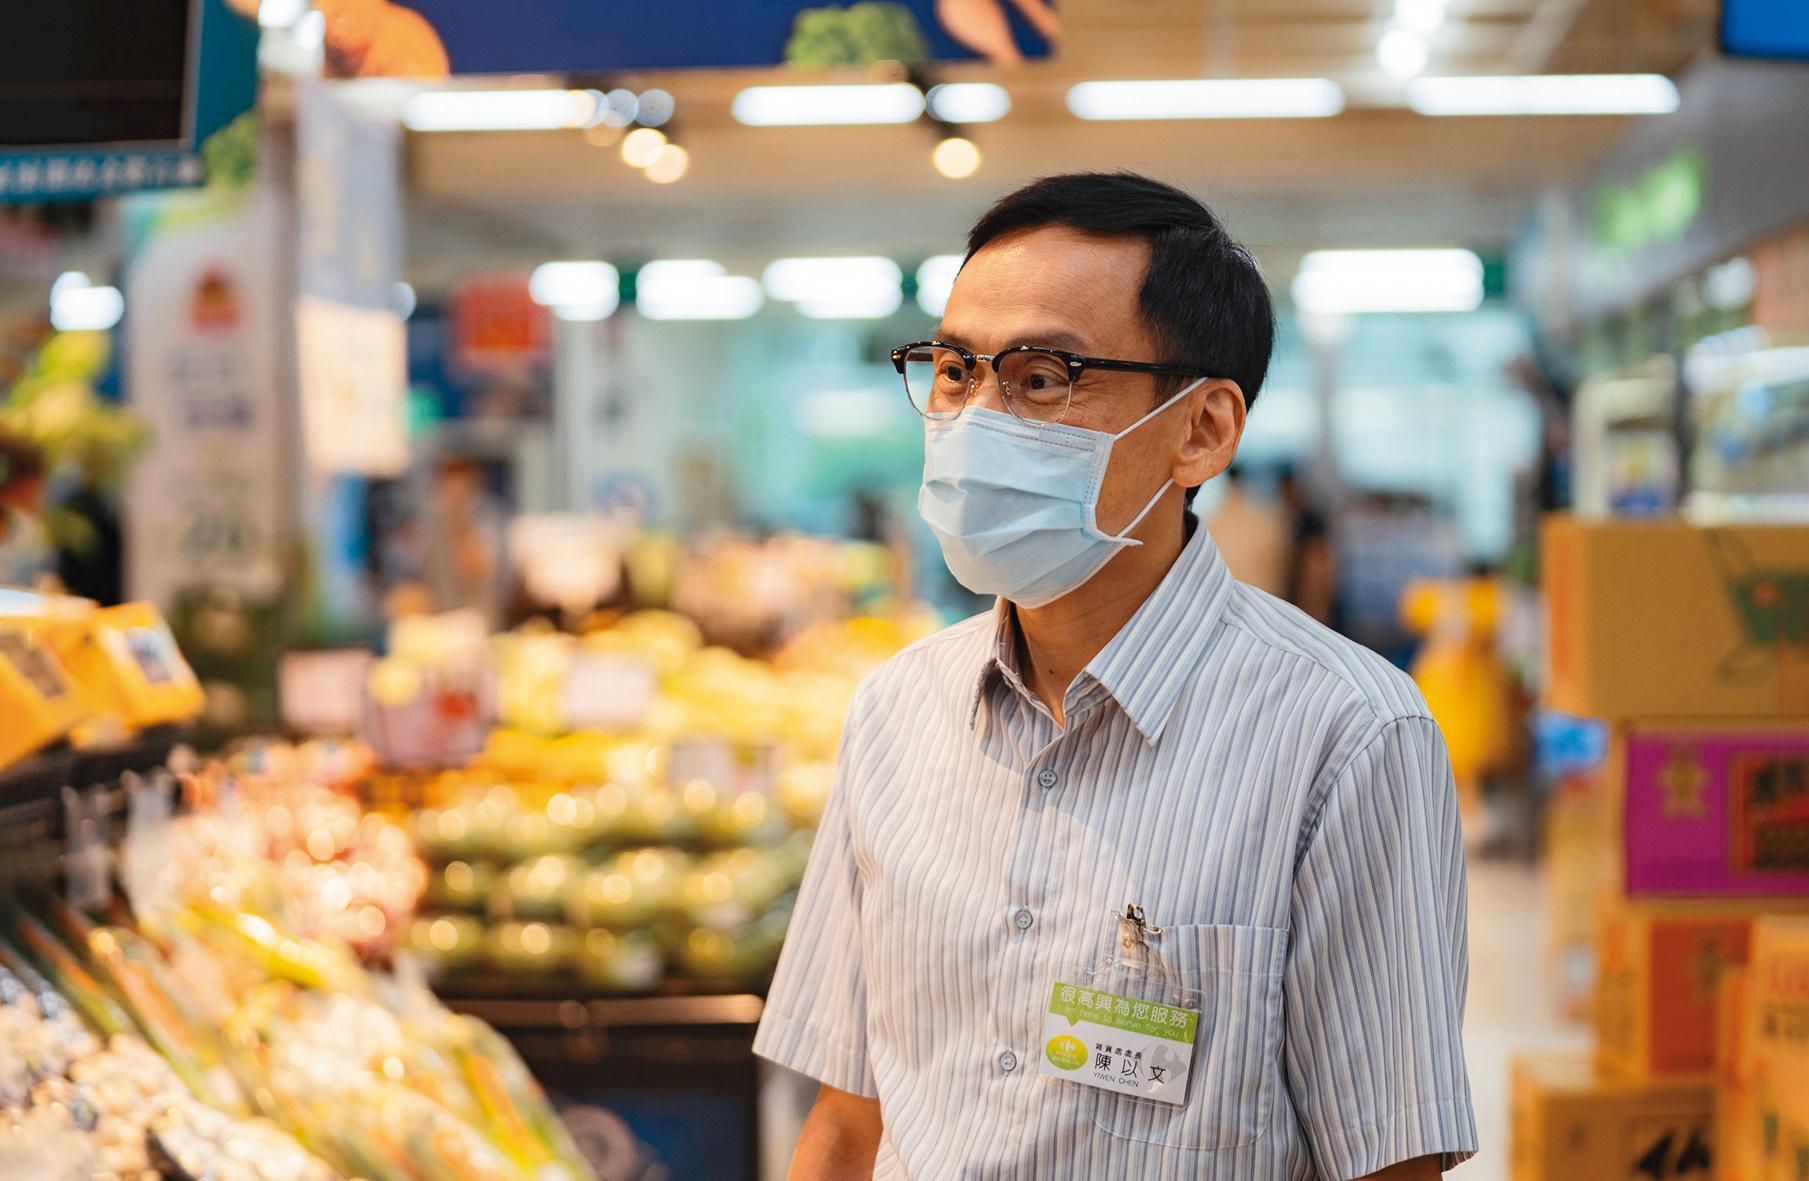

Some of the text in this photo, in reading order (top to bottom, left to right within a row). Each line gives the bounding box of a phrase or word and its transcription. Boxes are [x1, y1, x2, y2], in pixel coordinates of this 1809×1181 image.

[1059, 985, 1188, 1029] 很高興為您服務
[1103, 1014, 1113, 1024] to
[1145, 1023, 1159, 1033] for
[1164, 1028, 1180, 1038] you
[1093, 1071, 1140, 1088] YIWEN CHEN
[1094, 1052, 1166, 1085] 陳以文
